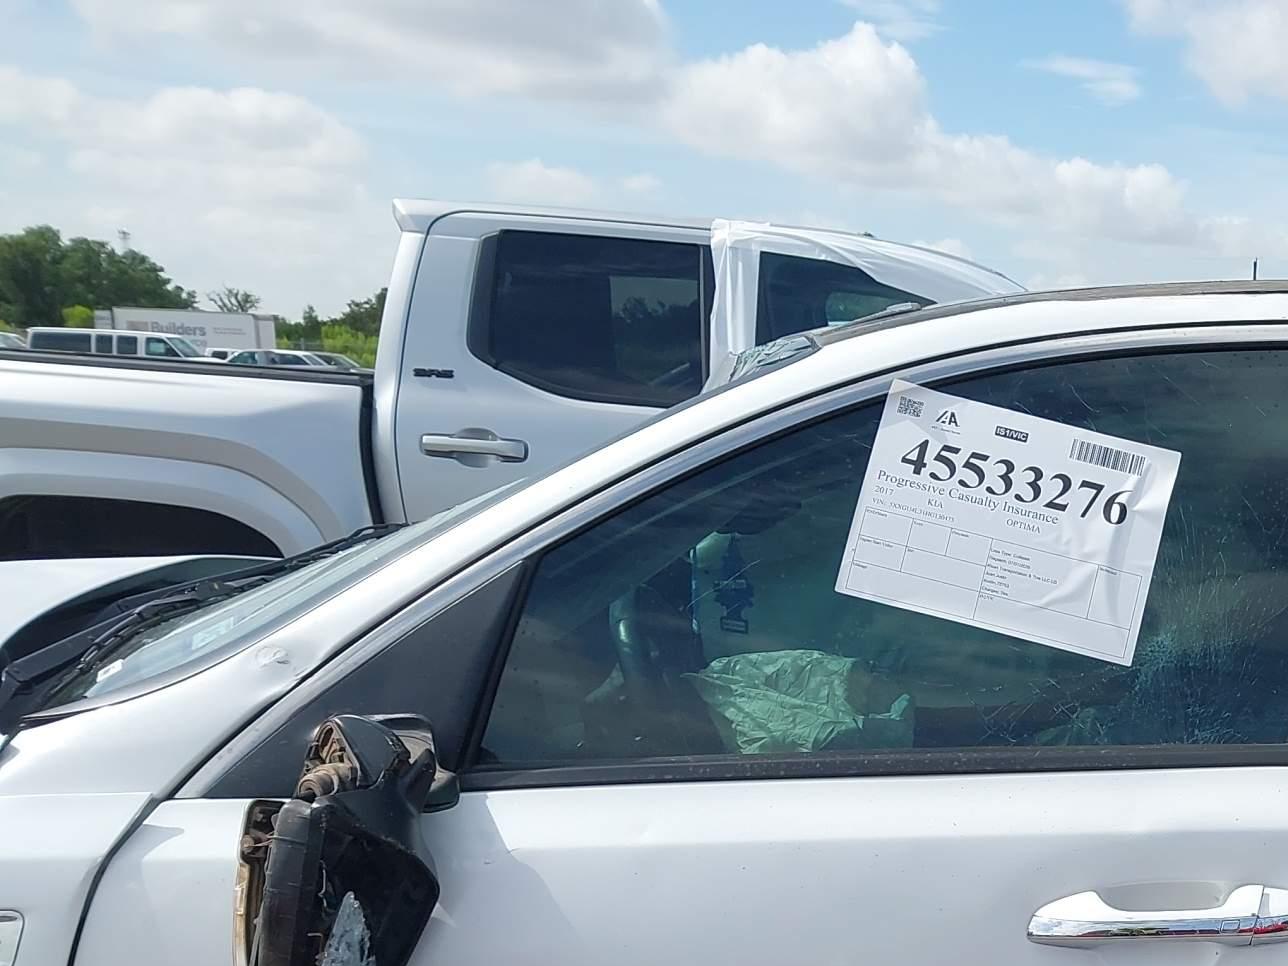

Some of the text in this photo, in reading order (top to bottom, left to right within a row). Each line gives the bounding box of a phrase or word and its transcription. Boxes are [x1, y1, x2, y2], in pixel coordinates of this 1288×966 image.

[151, 320, 207, 337] Builders
[877, 469, 1059, 525] Progressive Casualty Insurance
[900, 439, 1134, 526] 45533276
[874, 485, 1042, 534] 2017 KIA OPTIMA
